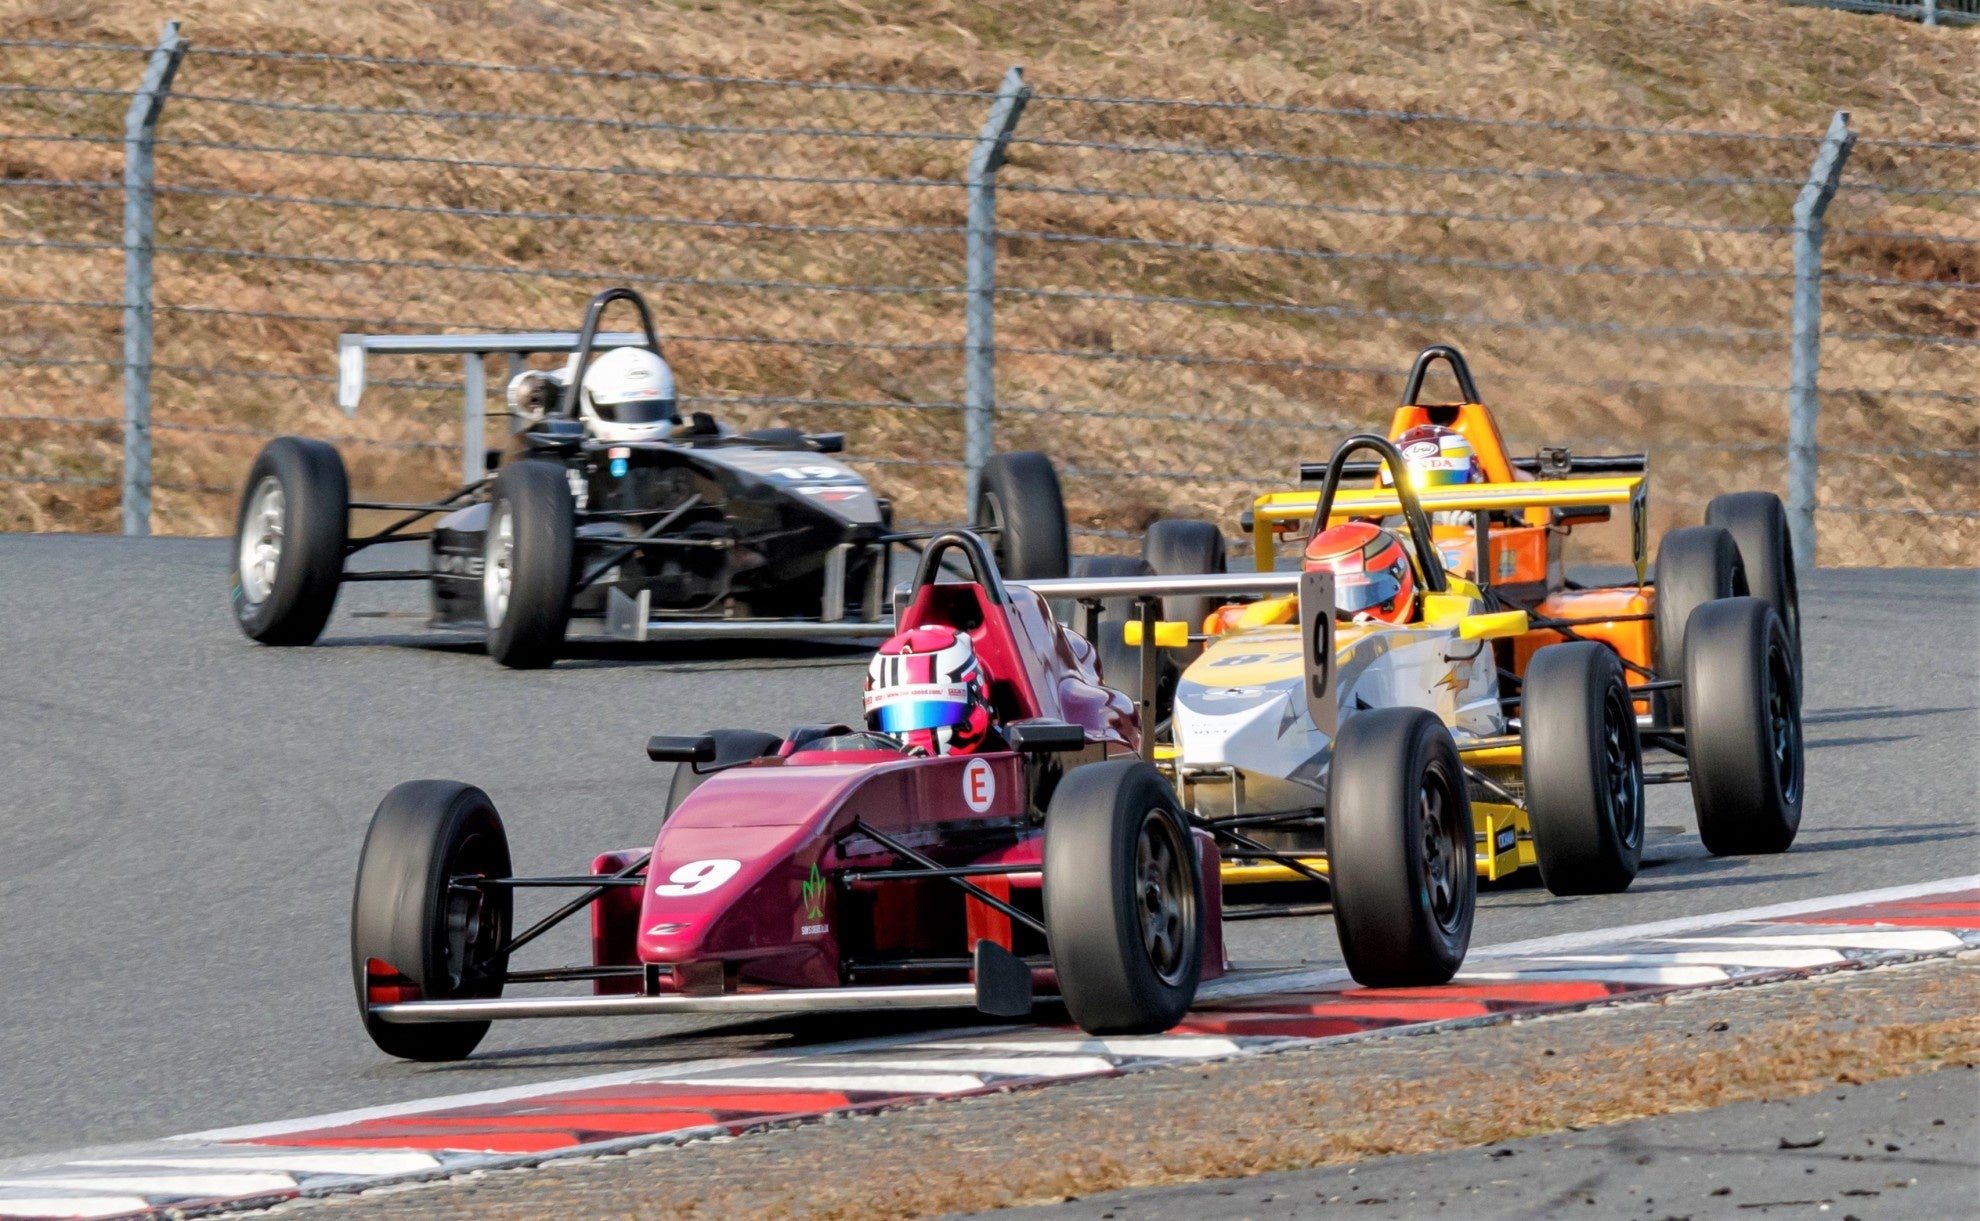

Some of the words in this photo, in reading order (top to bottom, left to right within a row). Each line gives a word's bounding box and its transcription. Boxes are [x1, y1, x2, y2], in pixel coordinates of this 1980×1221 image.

[771, 466, 840, 479] 19
[1312, 611, 1329, 699] 9
[971, 768, 987, 803] E
[655, 859, 741, 897] 9
